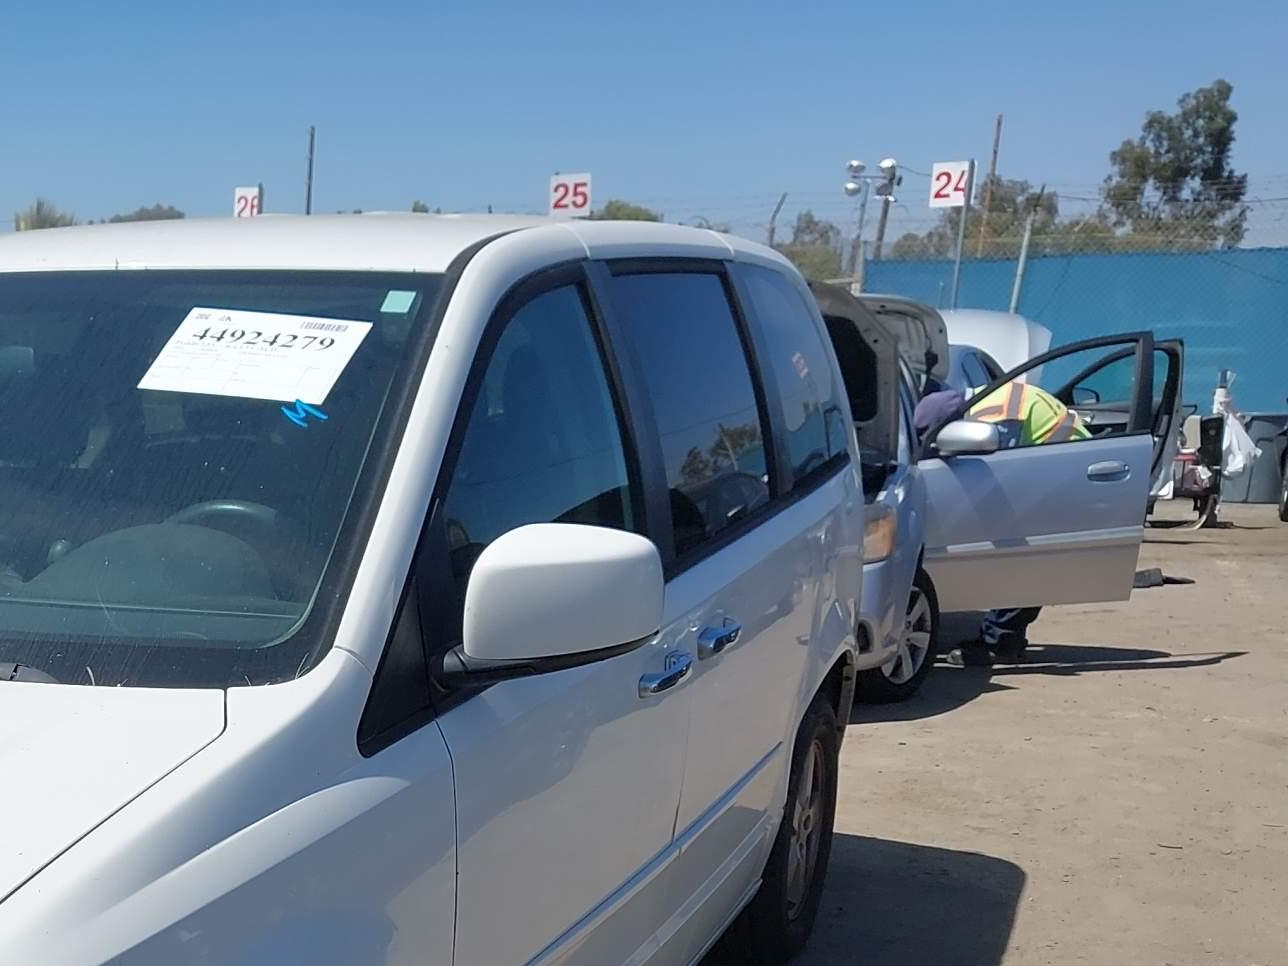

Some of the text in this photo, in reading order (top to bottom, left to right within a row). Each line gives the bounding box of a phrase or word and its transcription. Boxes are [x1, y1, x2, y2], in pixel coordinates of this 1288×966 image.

[552, 182, 588, 209] 25
[933, 169, 969, 199] 24
[192, 326, 336, 351] 44924279
